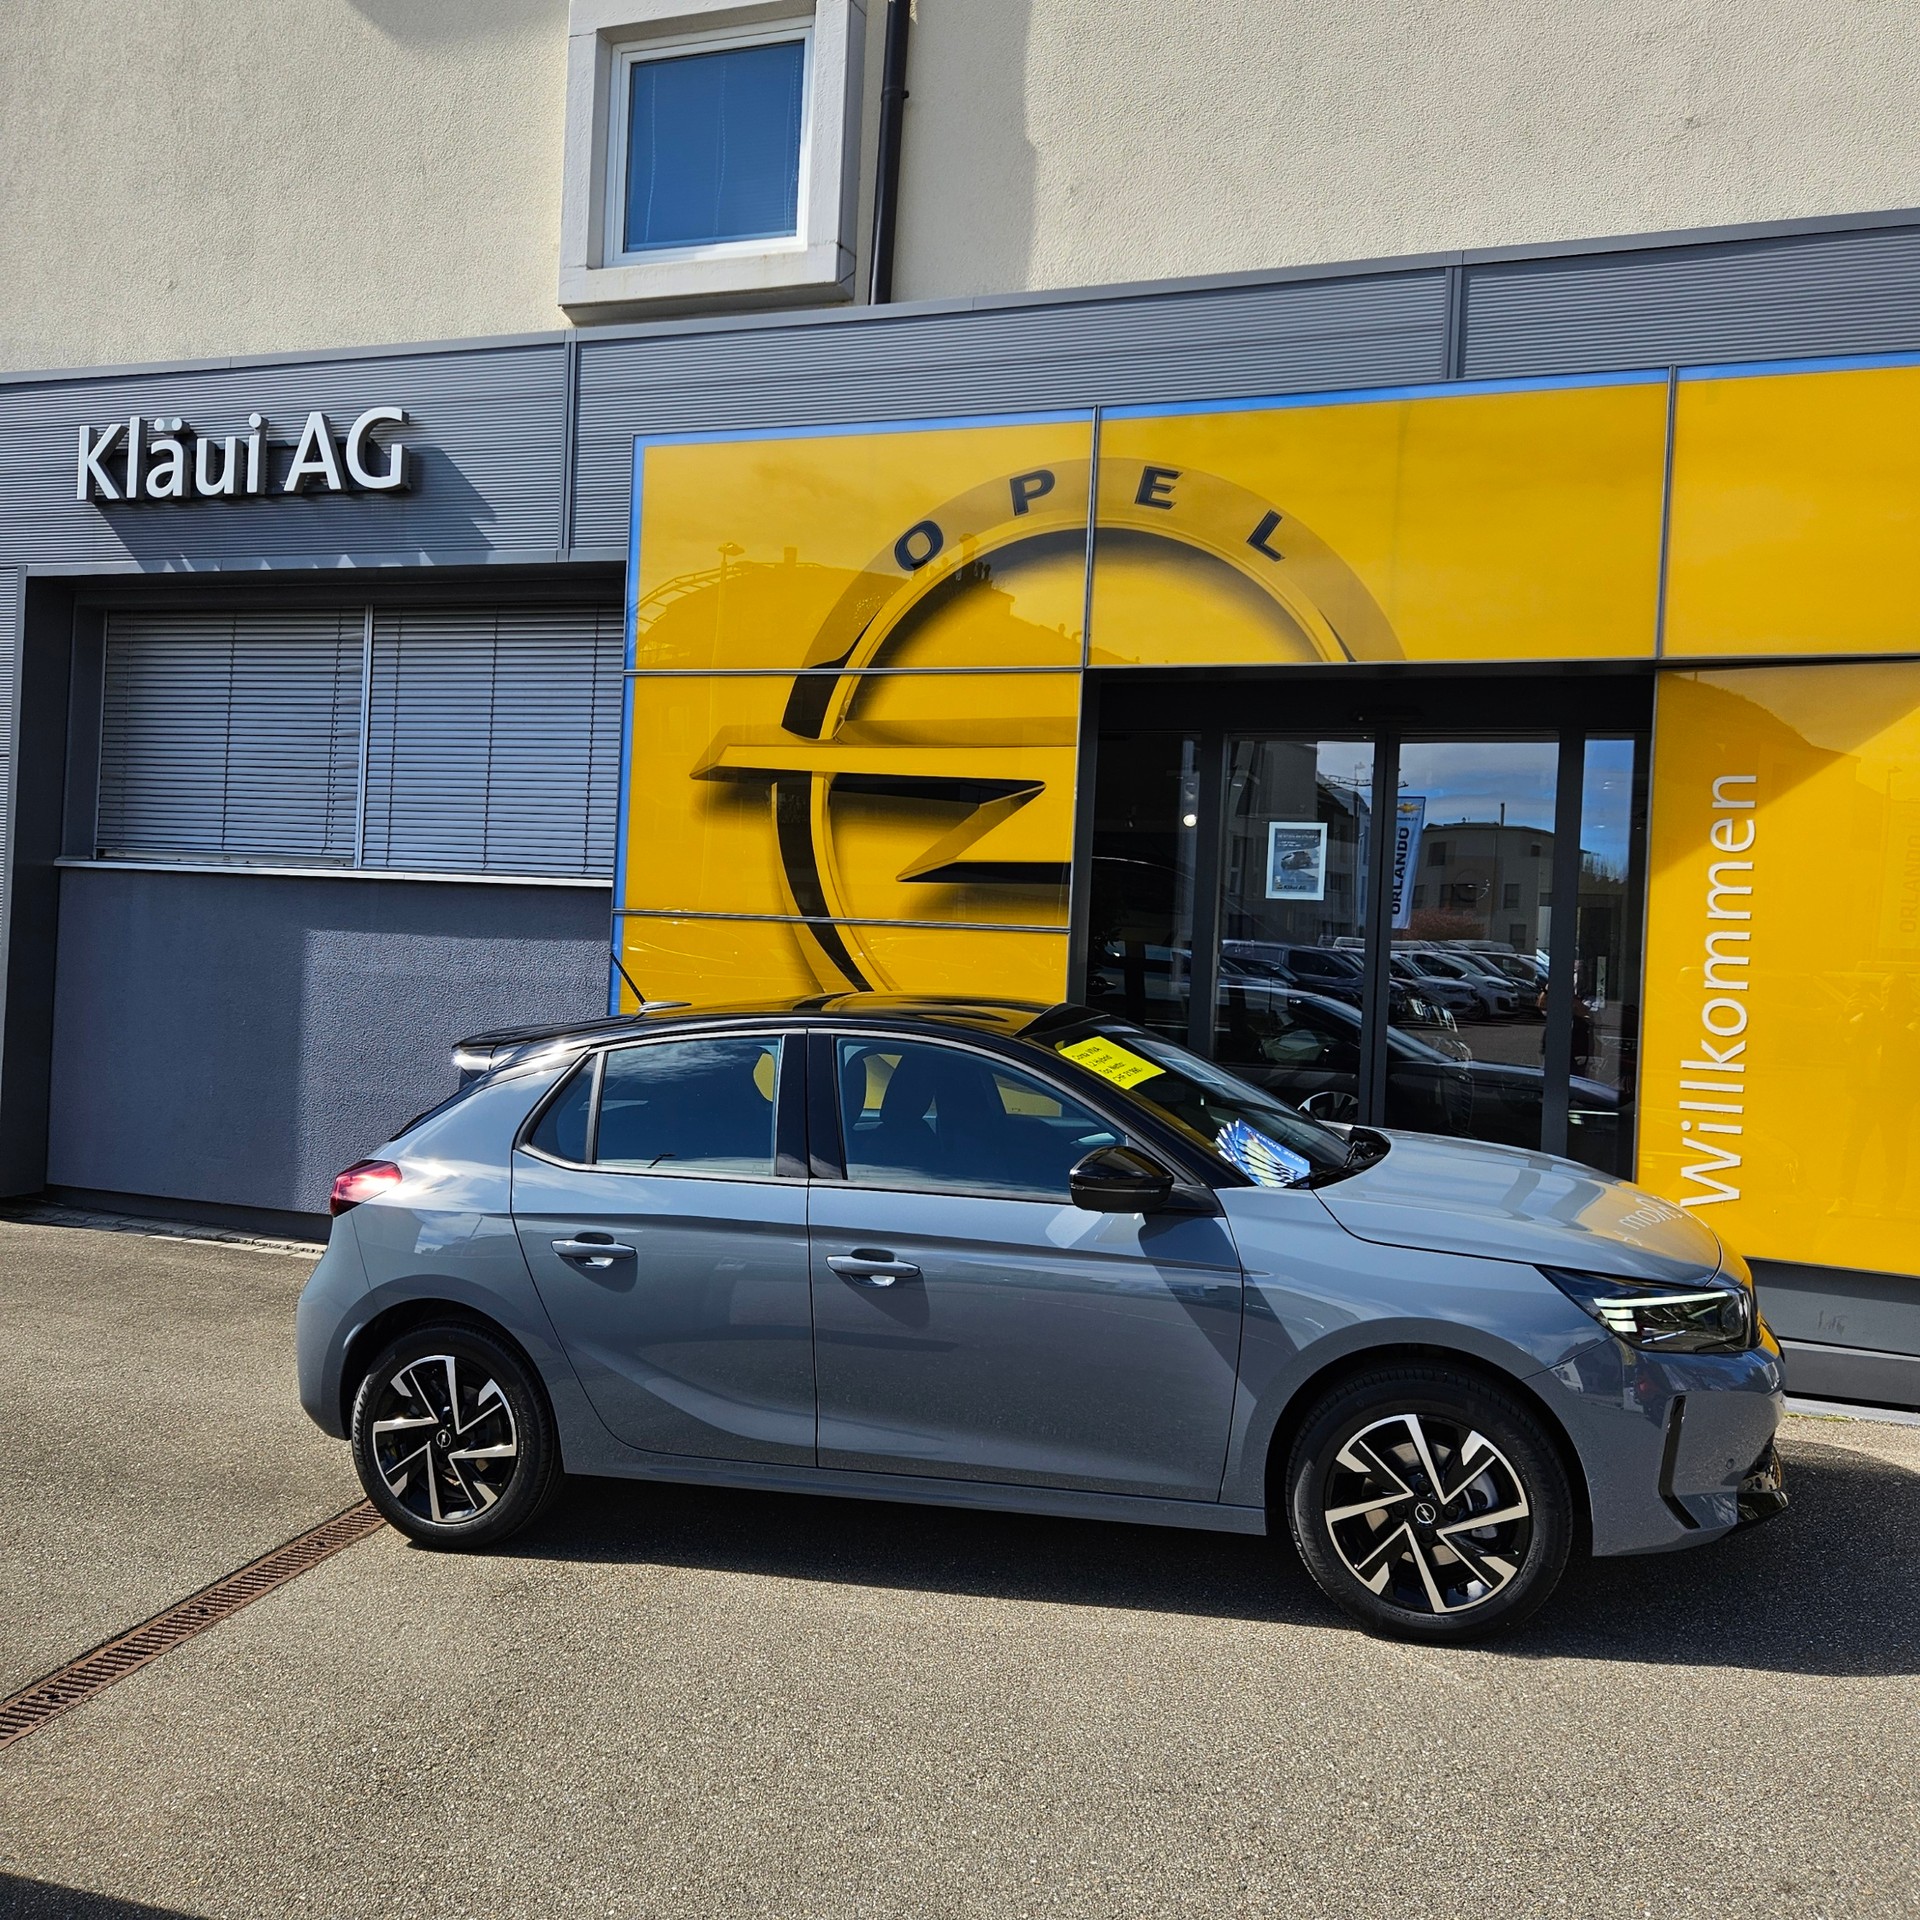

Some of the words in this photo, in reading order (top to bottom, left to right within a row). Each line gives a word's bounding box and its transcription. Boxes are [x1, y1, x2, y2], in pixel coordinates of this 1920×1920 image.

[77, 411, 266, 500] Kläui
[283, 407, 407, 493] AG
[894, 466, 1285, 571] OPEL
[1391, 827, 1410, 915] ORLANDO
[1679, 773, 1757, 1207] Willkommen
